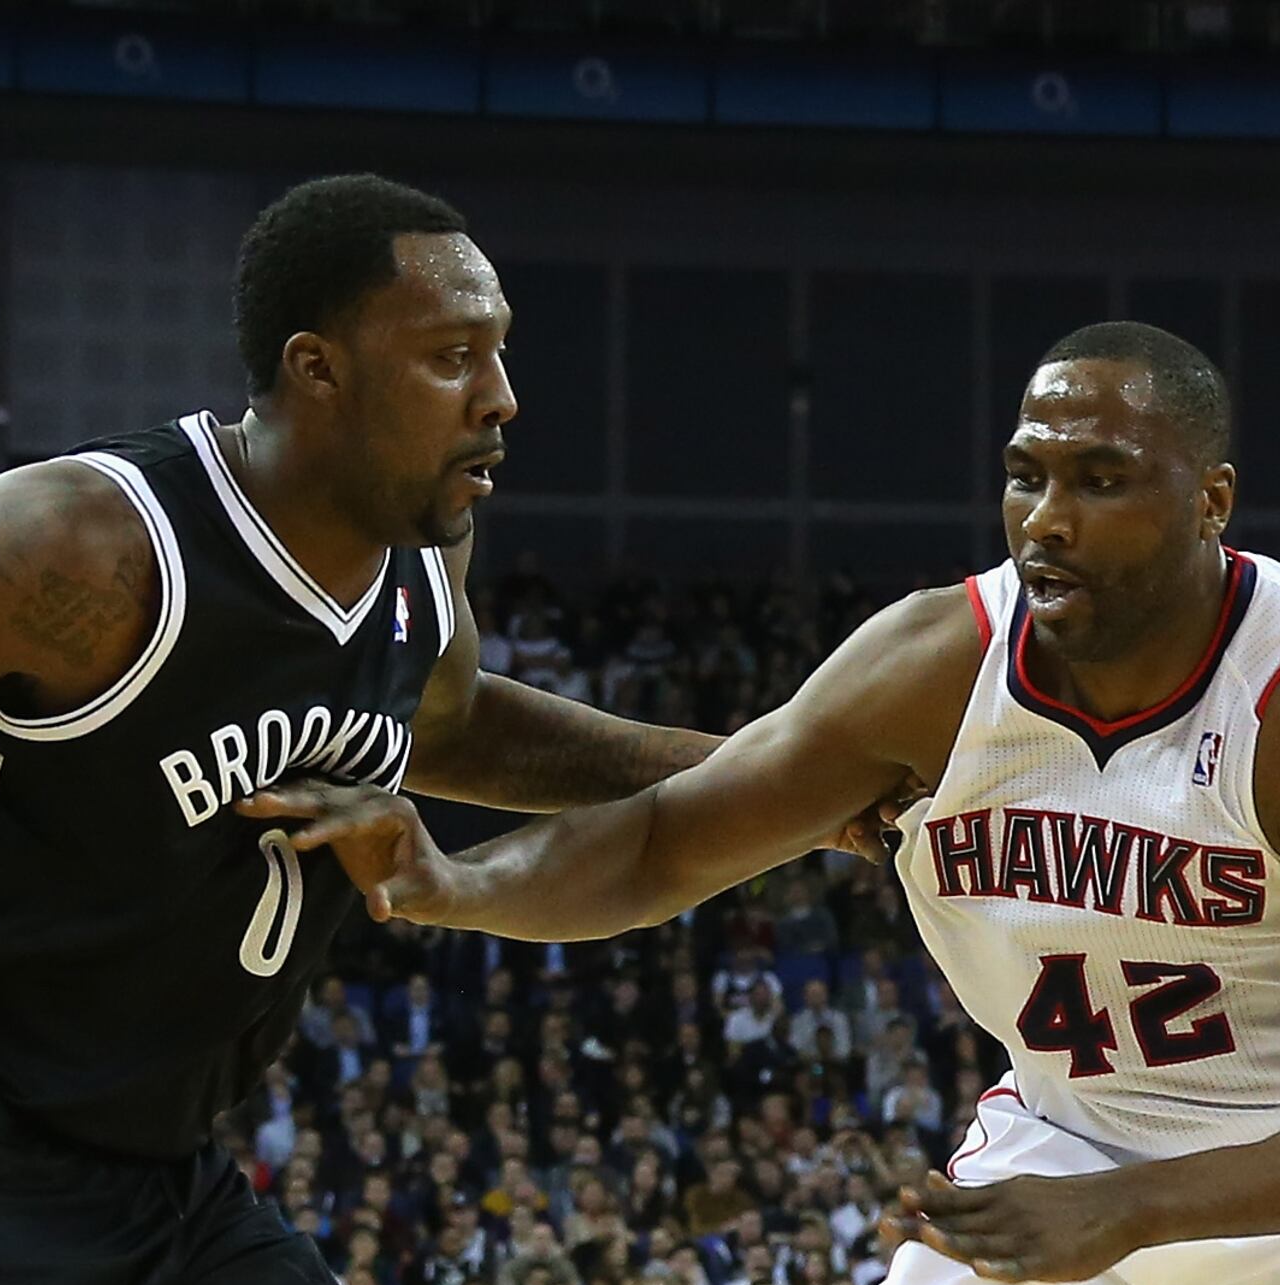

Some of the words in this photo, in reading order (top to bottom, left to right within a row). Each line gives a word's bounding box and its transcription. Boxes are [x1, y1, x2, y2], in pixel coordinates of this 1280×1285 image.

[238, 828, 304, 978] 0
[925, 807, 1267, 928] HAWKS
[1016, 952, 1237, 1079] 42
